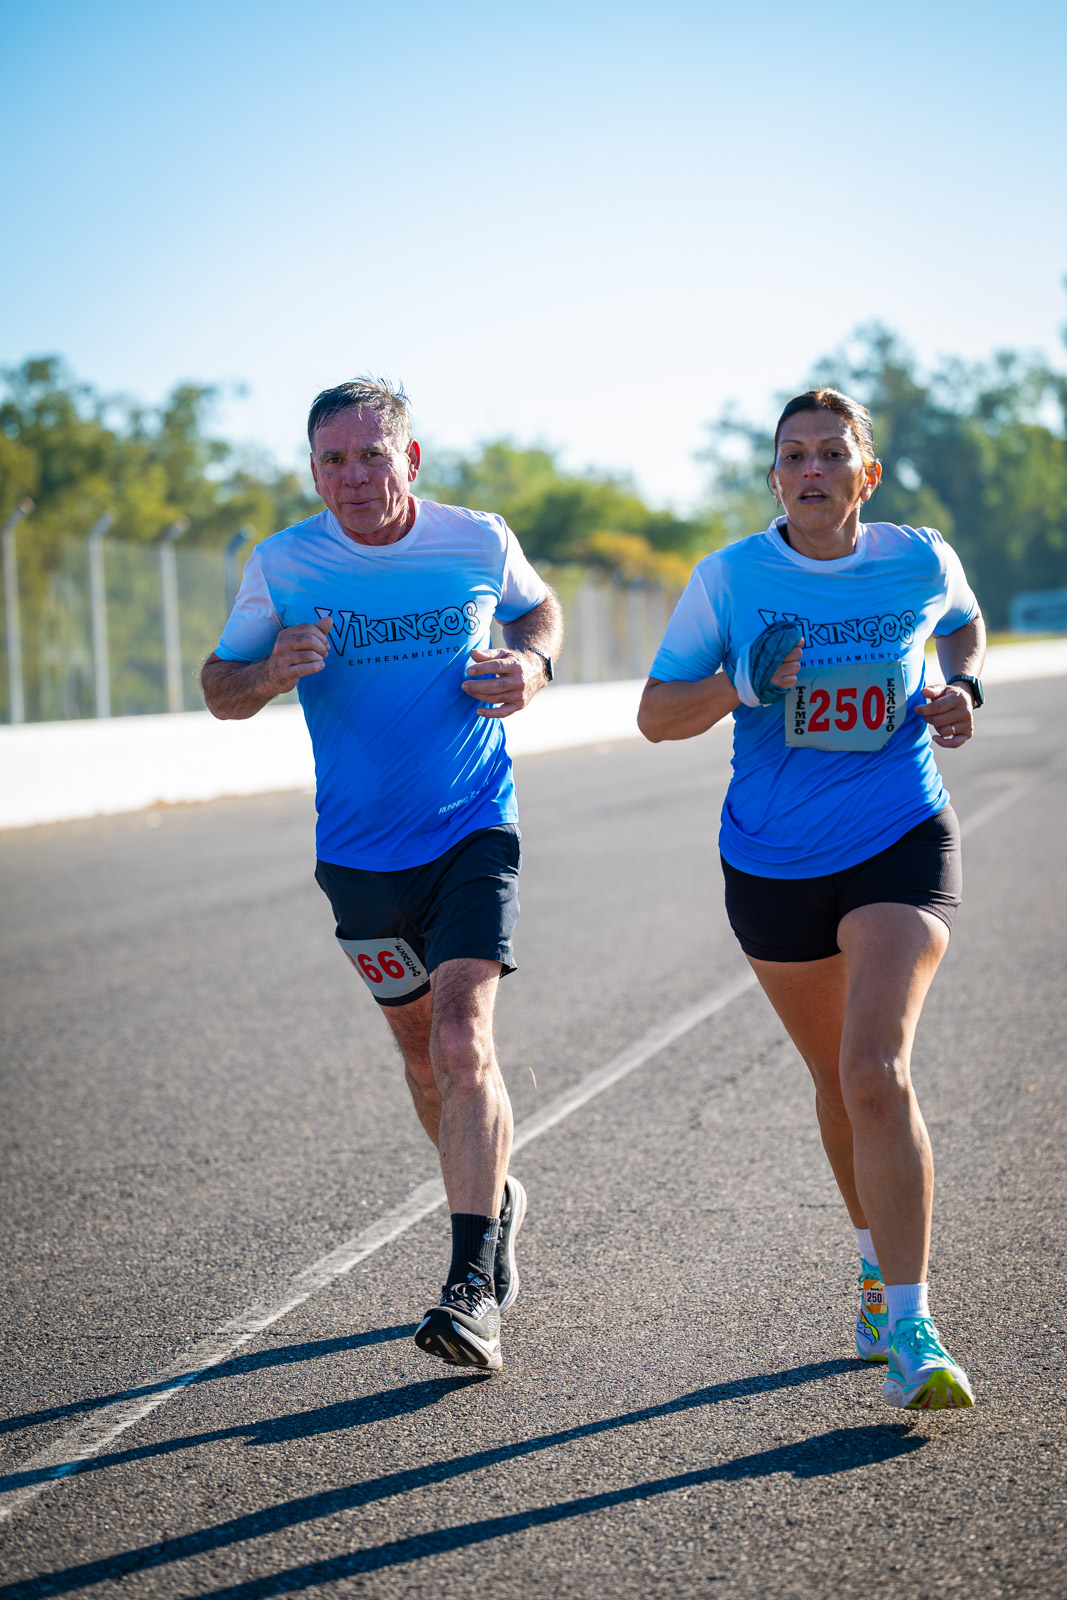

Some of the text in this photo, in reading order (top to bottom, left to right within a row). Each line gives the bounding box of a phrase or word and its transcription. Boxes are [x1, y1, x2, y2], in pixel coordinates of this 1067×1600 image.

[348, 645, 460, 666] ENTRENAMIENTO
[800, 652, 900, 668] NTRENAMIENTO
[794, 686, 806, 736] TIEMPO
[807, 685, 886, 733] 250
[885, 678, 896, 733] EXACTO
[343, 949, 405, 984] 66
[867, 1292, 882, 1303] 250
